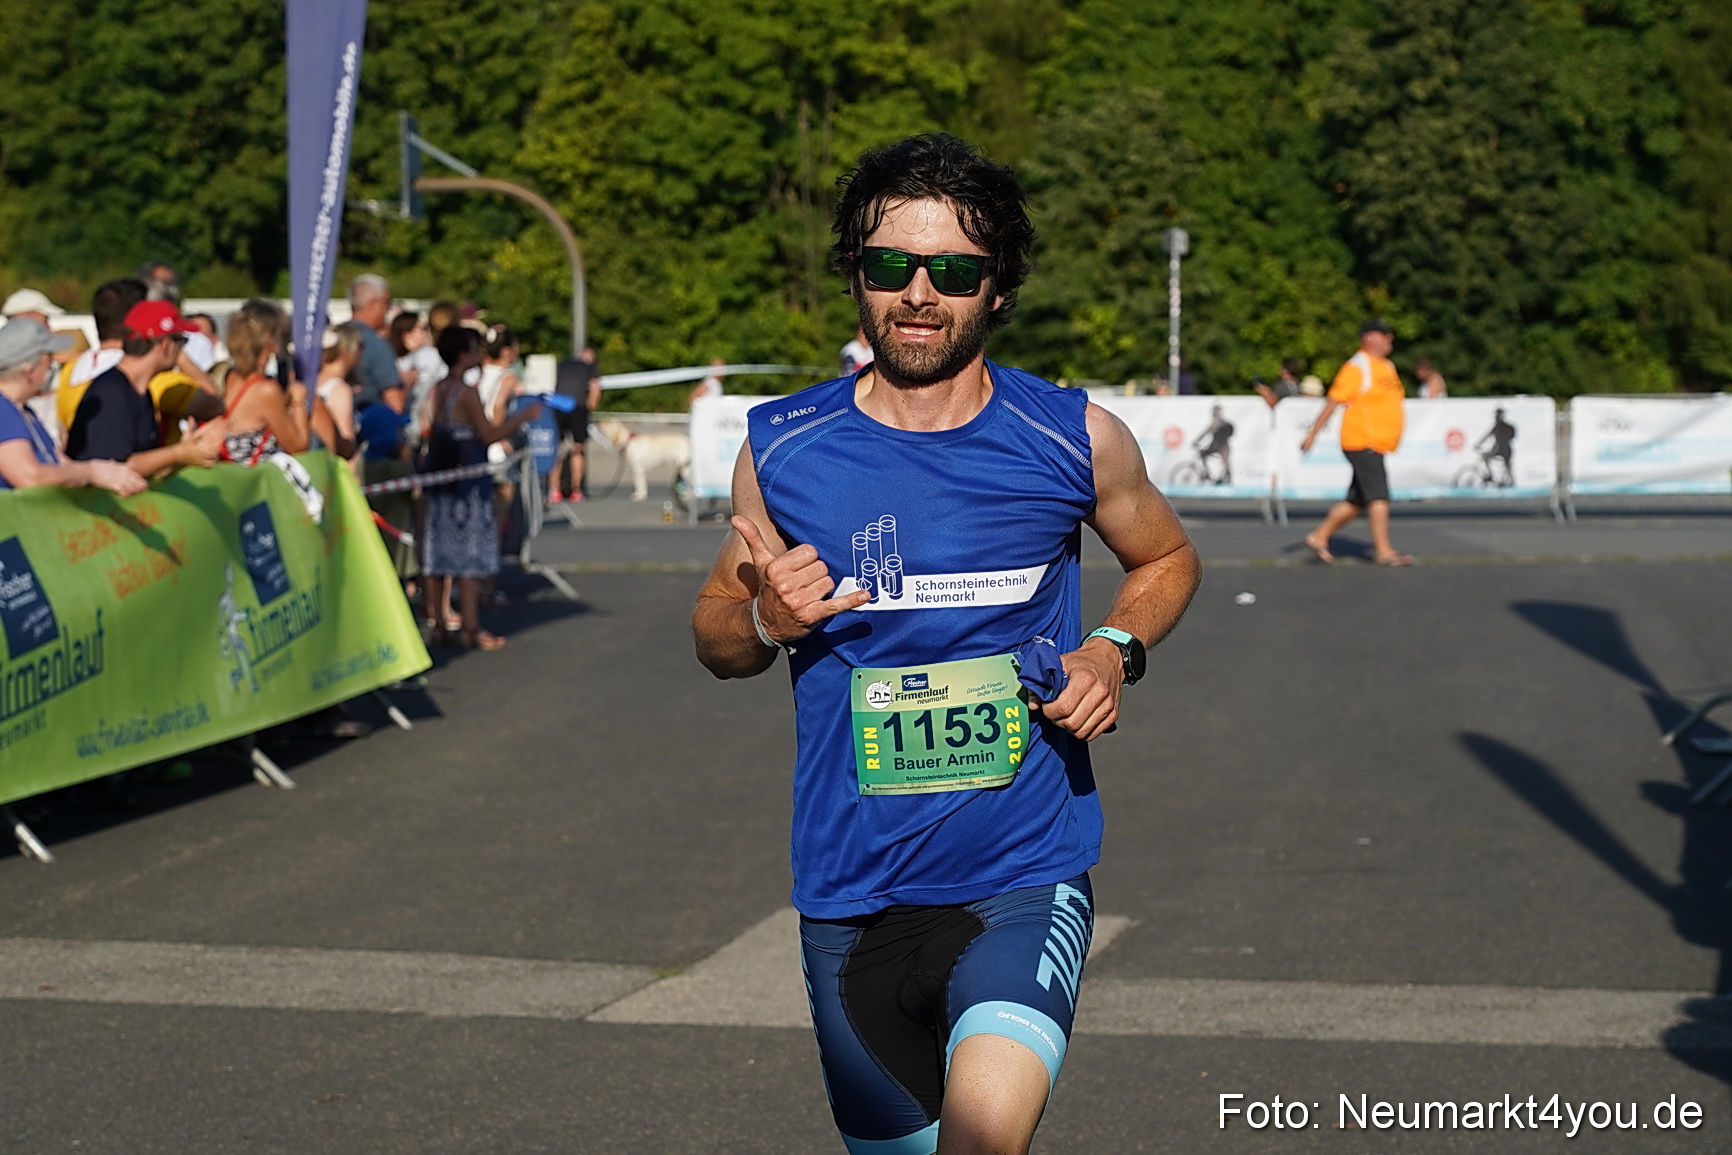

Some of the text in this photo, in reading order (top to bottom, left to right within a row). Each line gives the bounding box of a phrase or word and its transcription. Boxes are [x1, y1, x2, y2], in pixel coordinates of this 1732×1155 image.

[787, 405, 817, 420] JAKO
[915, 574, 1028, 591] Schornsteintechnik
[915, 590, 976, 603] Neumarkt
[0, 607, 104, 724] irmenlauf
[895, 685, 949, 702] Firmenlauf
[916, 695, 949, 705] neumarkt
[883, 702, 1001, 753] 1153
[1004, 705, 1022, 765] 2022
[863, 727, 881, 770] RUN
[894, 750, 995, 771] Bauer Armin
[905, 769, 986, 782] Schornsteintechnik Neumarkt
